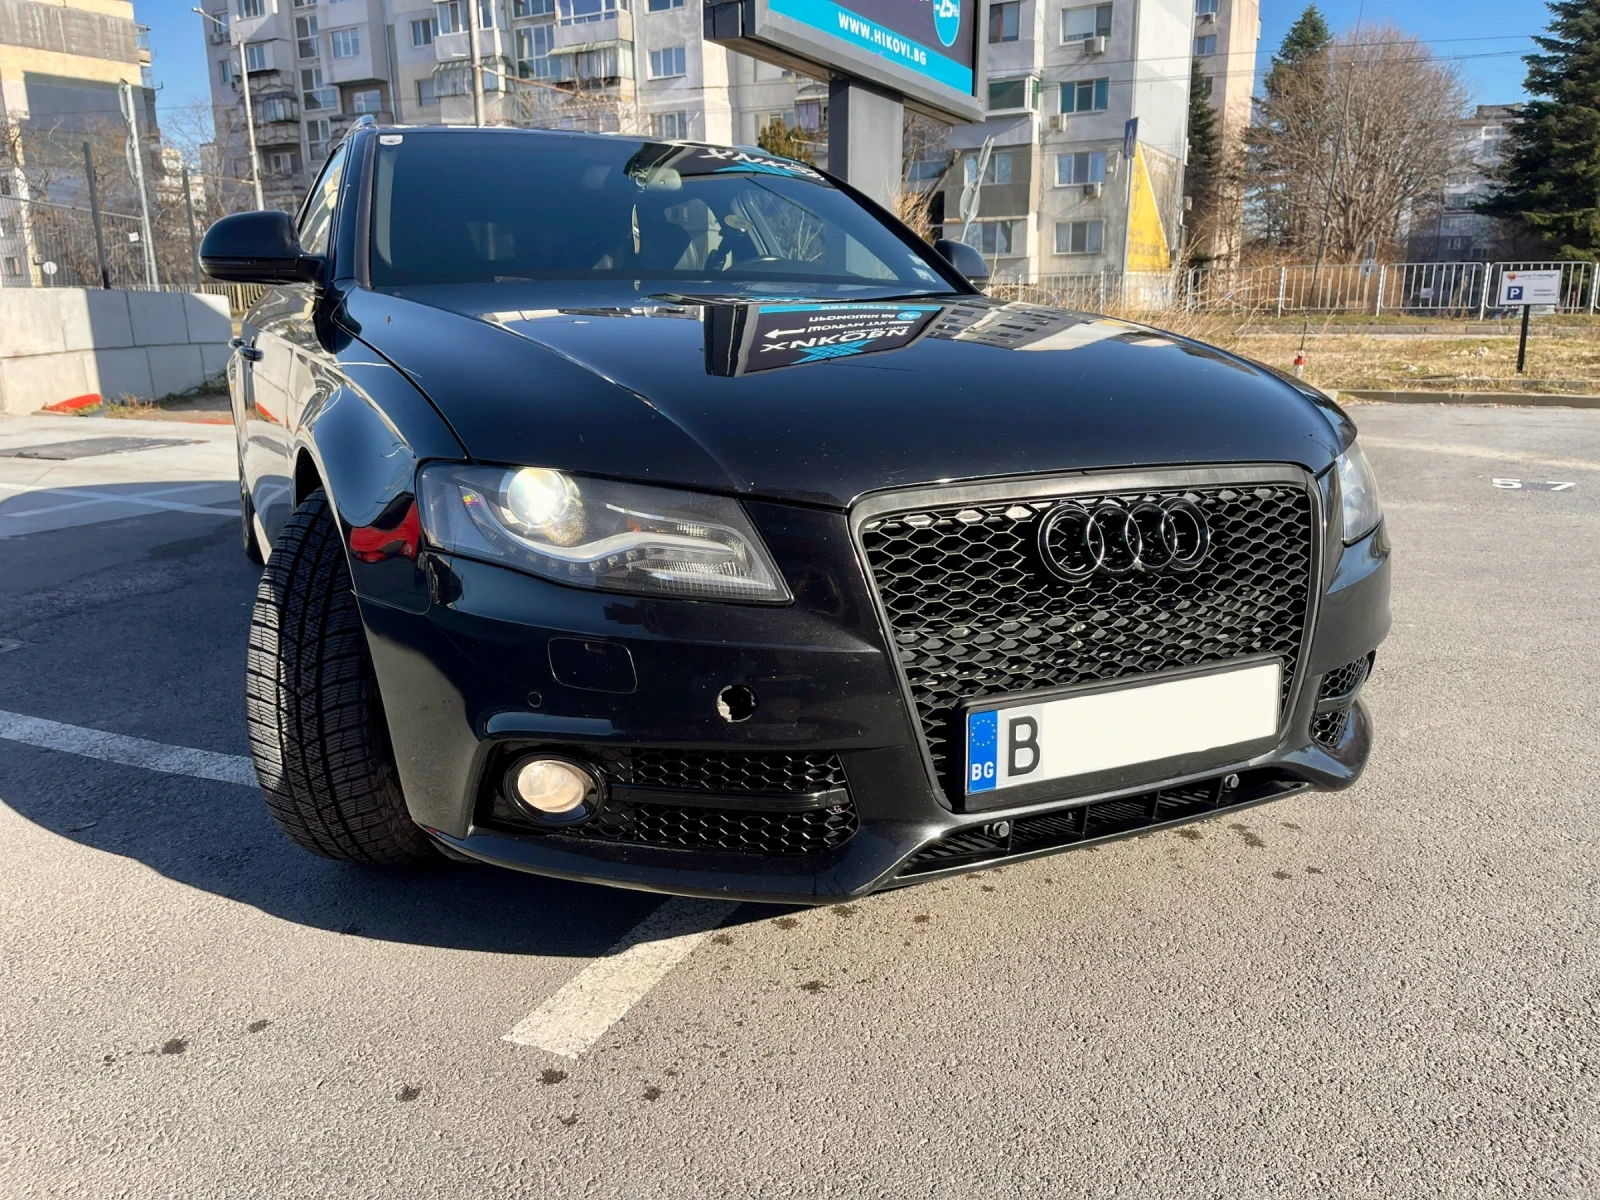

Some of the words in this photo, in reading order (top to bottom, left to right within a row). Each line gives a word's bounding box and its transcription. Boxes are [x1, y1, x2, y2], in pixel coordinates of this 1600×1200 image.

[838, 11, 927, 65] WWW.HIKOVI.BG
[1510, 287, 1520, 298] P
[1008, 715, 1040, 777] B
[972, 761, 993, 781] BG
